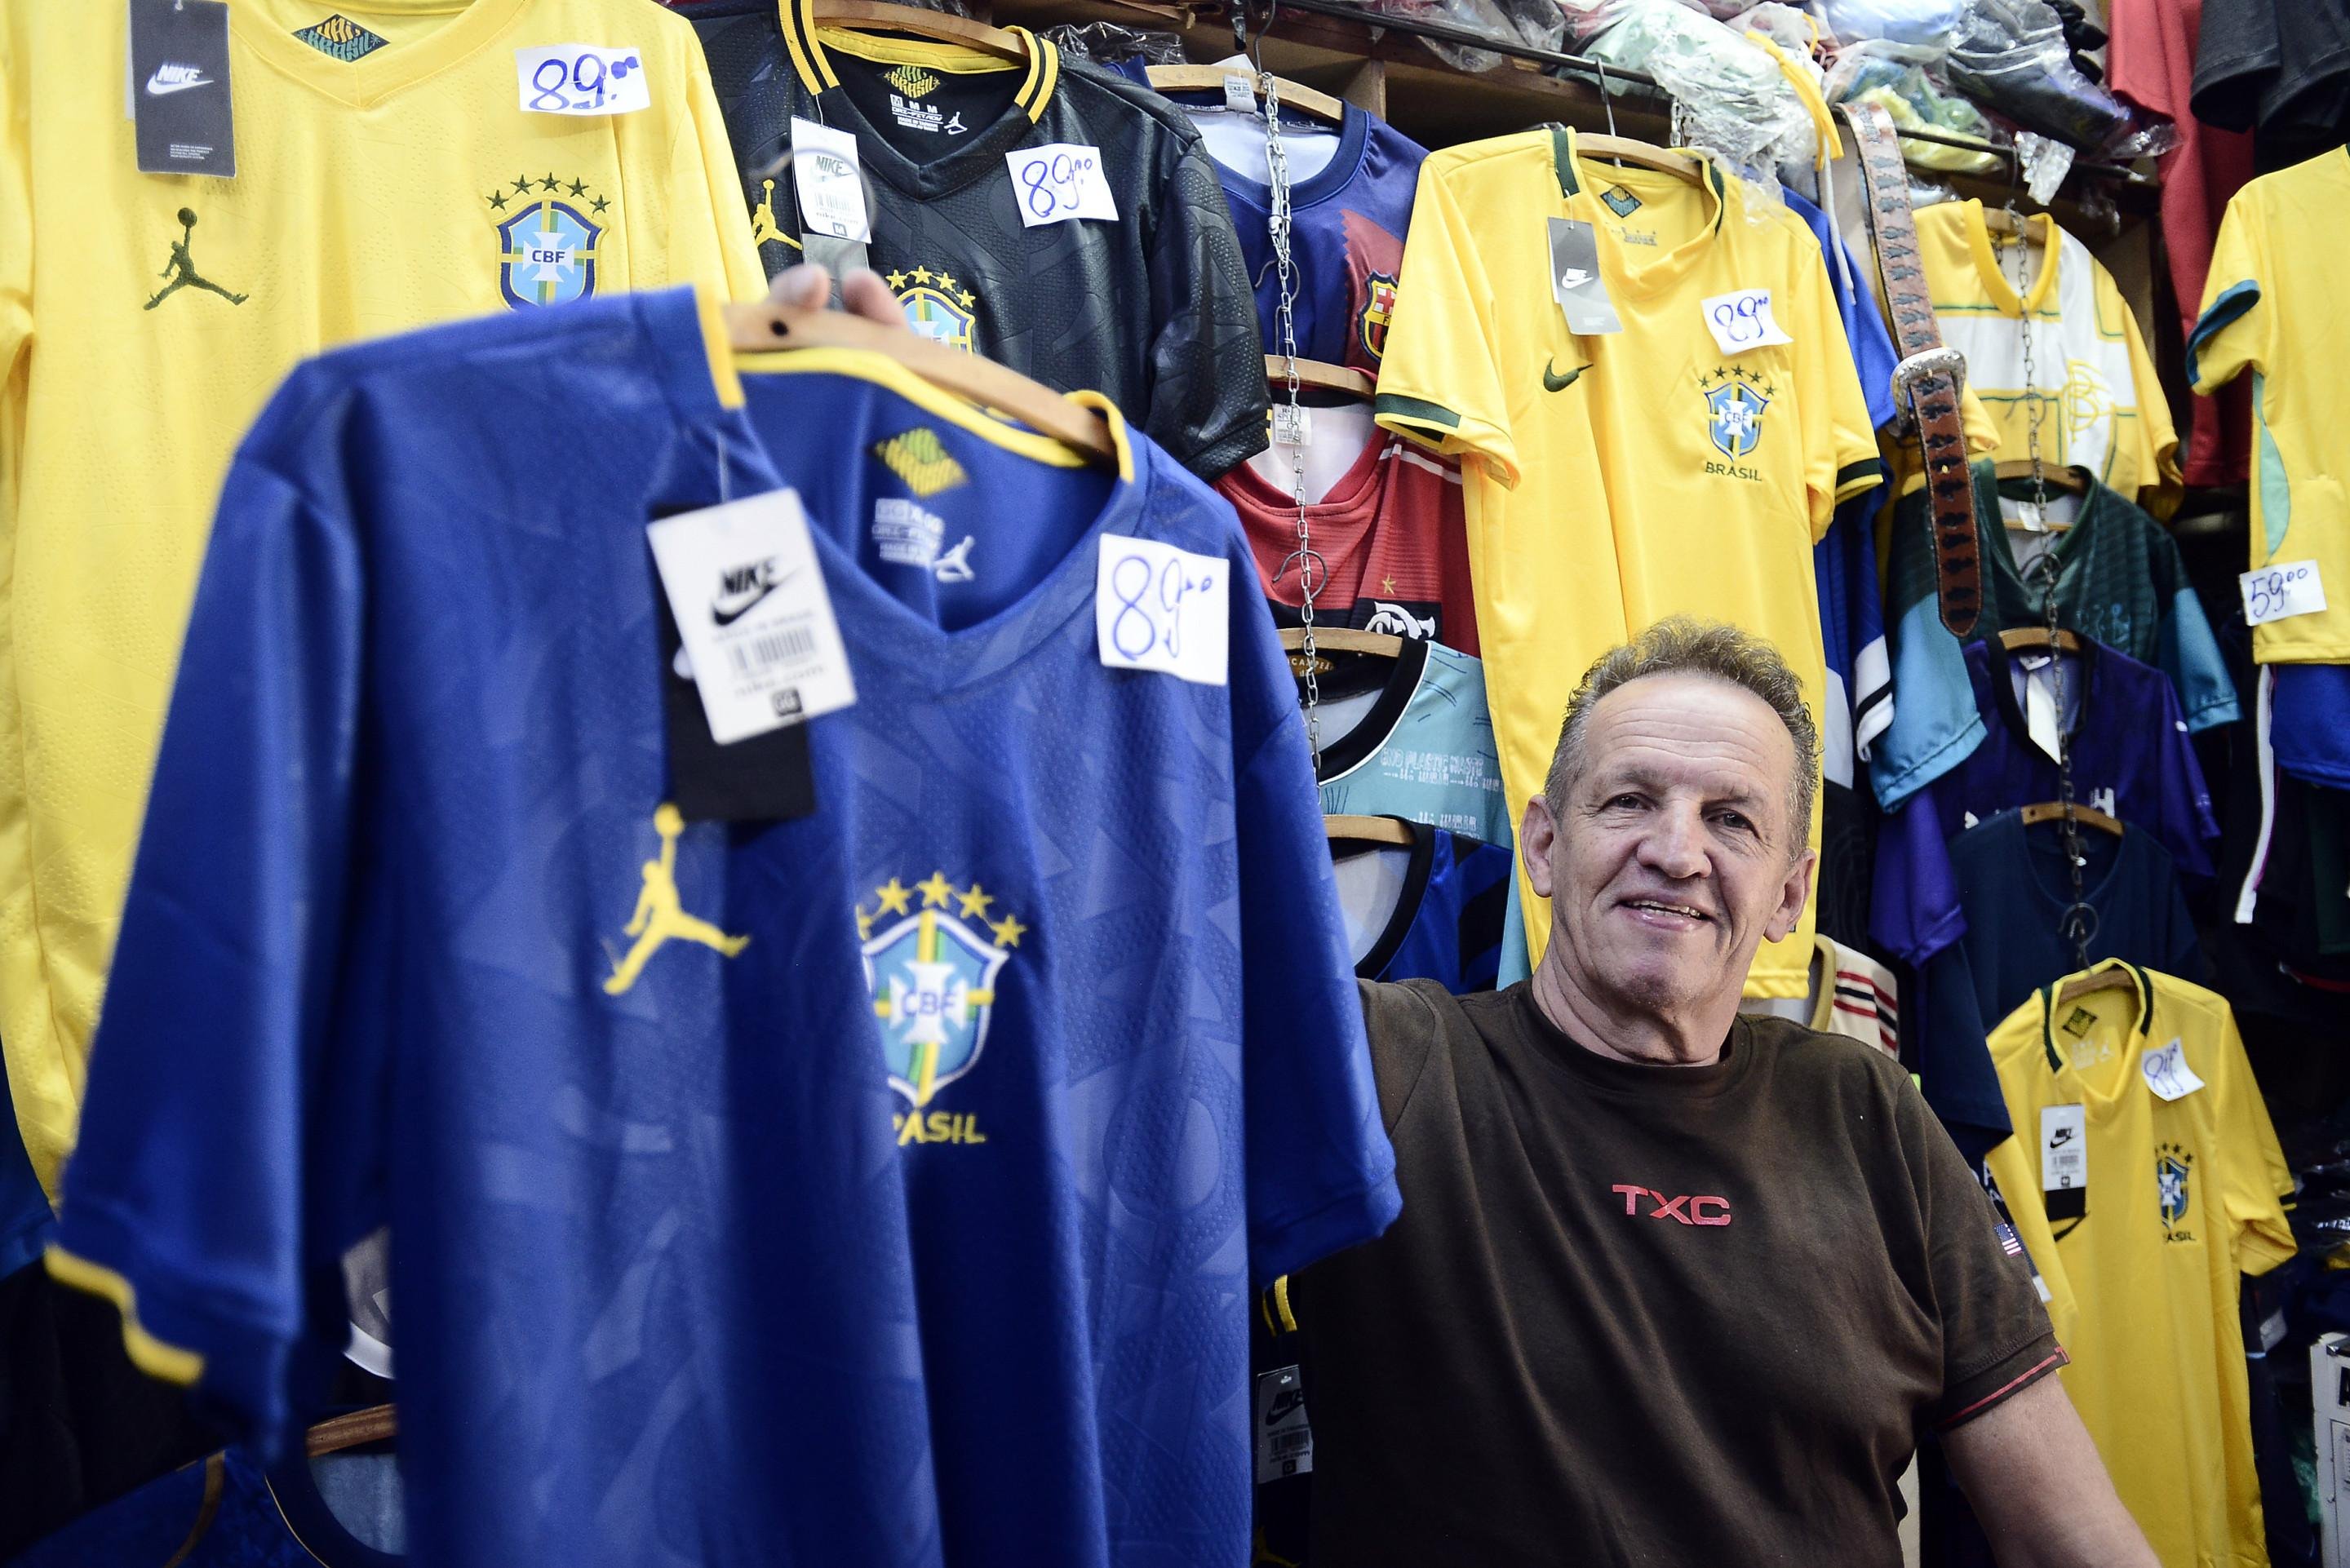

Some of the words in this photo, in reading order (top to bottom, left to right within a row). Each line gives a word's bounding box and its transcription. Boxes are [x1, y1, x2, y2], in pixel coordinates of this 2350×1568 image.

[307, 29, 372, 61] BRASIL
[156, 64, 201, 82] NIKE
[891, 71, 935, 98] BRASIL
[815, 155, 844, 176] NIKE
[532, 250, 565, 263] CBF
[1724, 411, 1749, 423] CBF
[1705, 461, 1762, 482] BRASIL
[720, 555, 778, 598] NIKE
[902, 992, 956, 1017] CBF
[892, 1110, 987, 1146] ASIL
[1612, 1184, 1731, 1226] TXC
